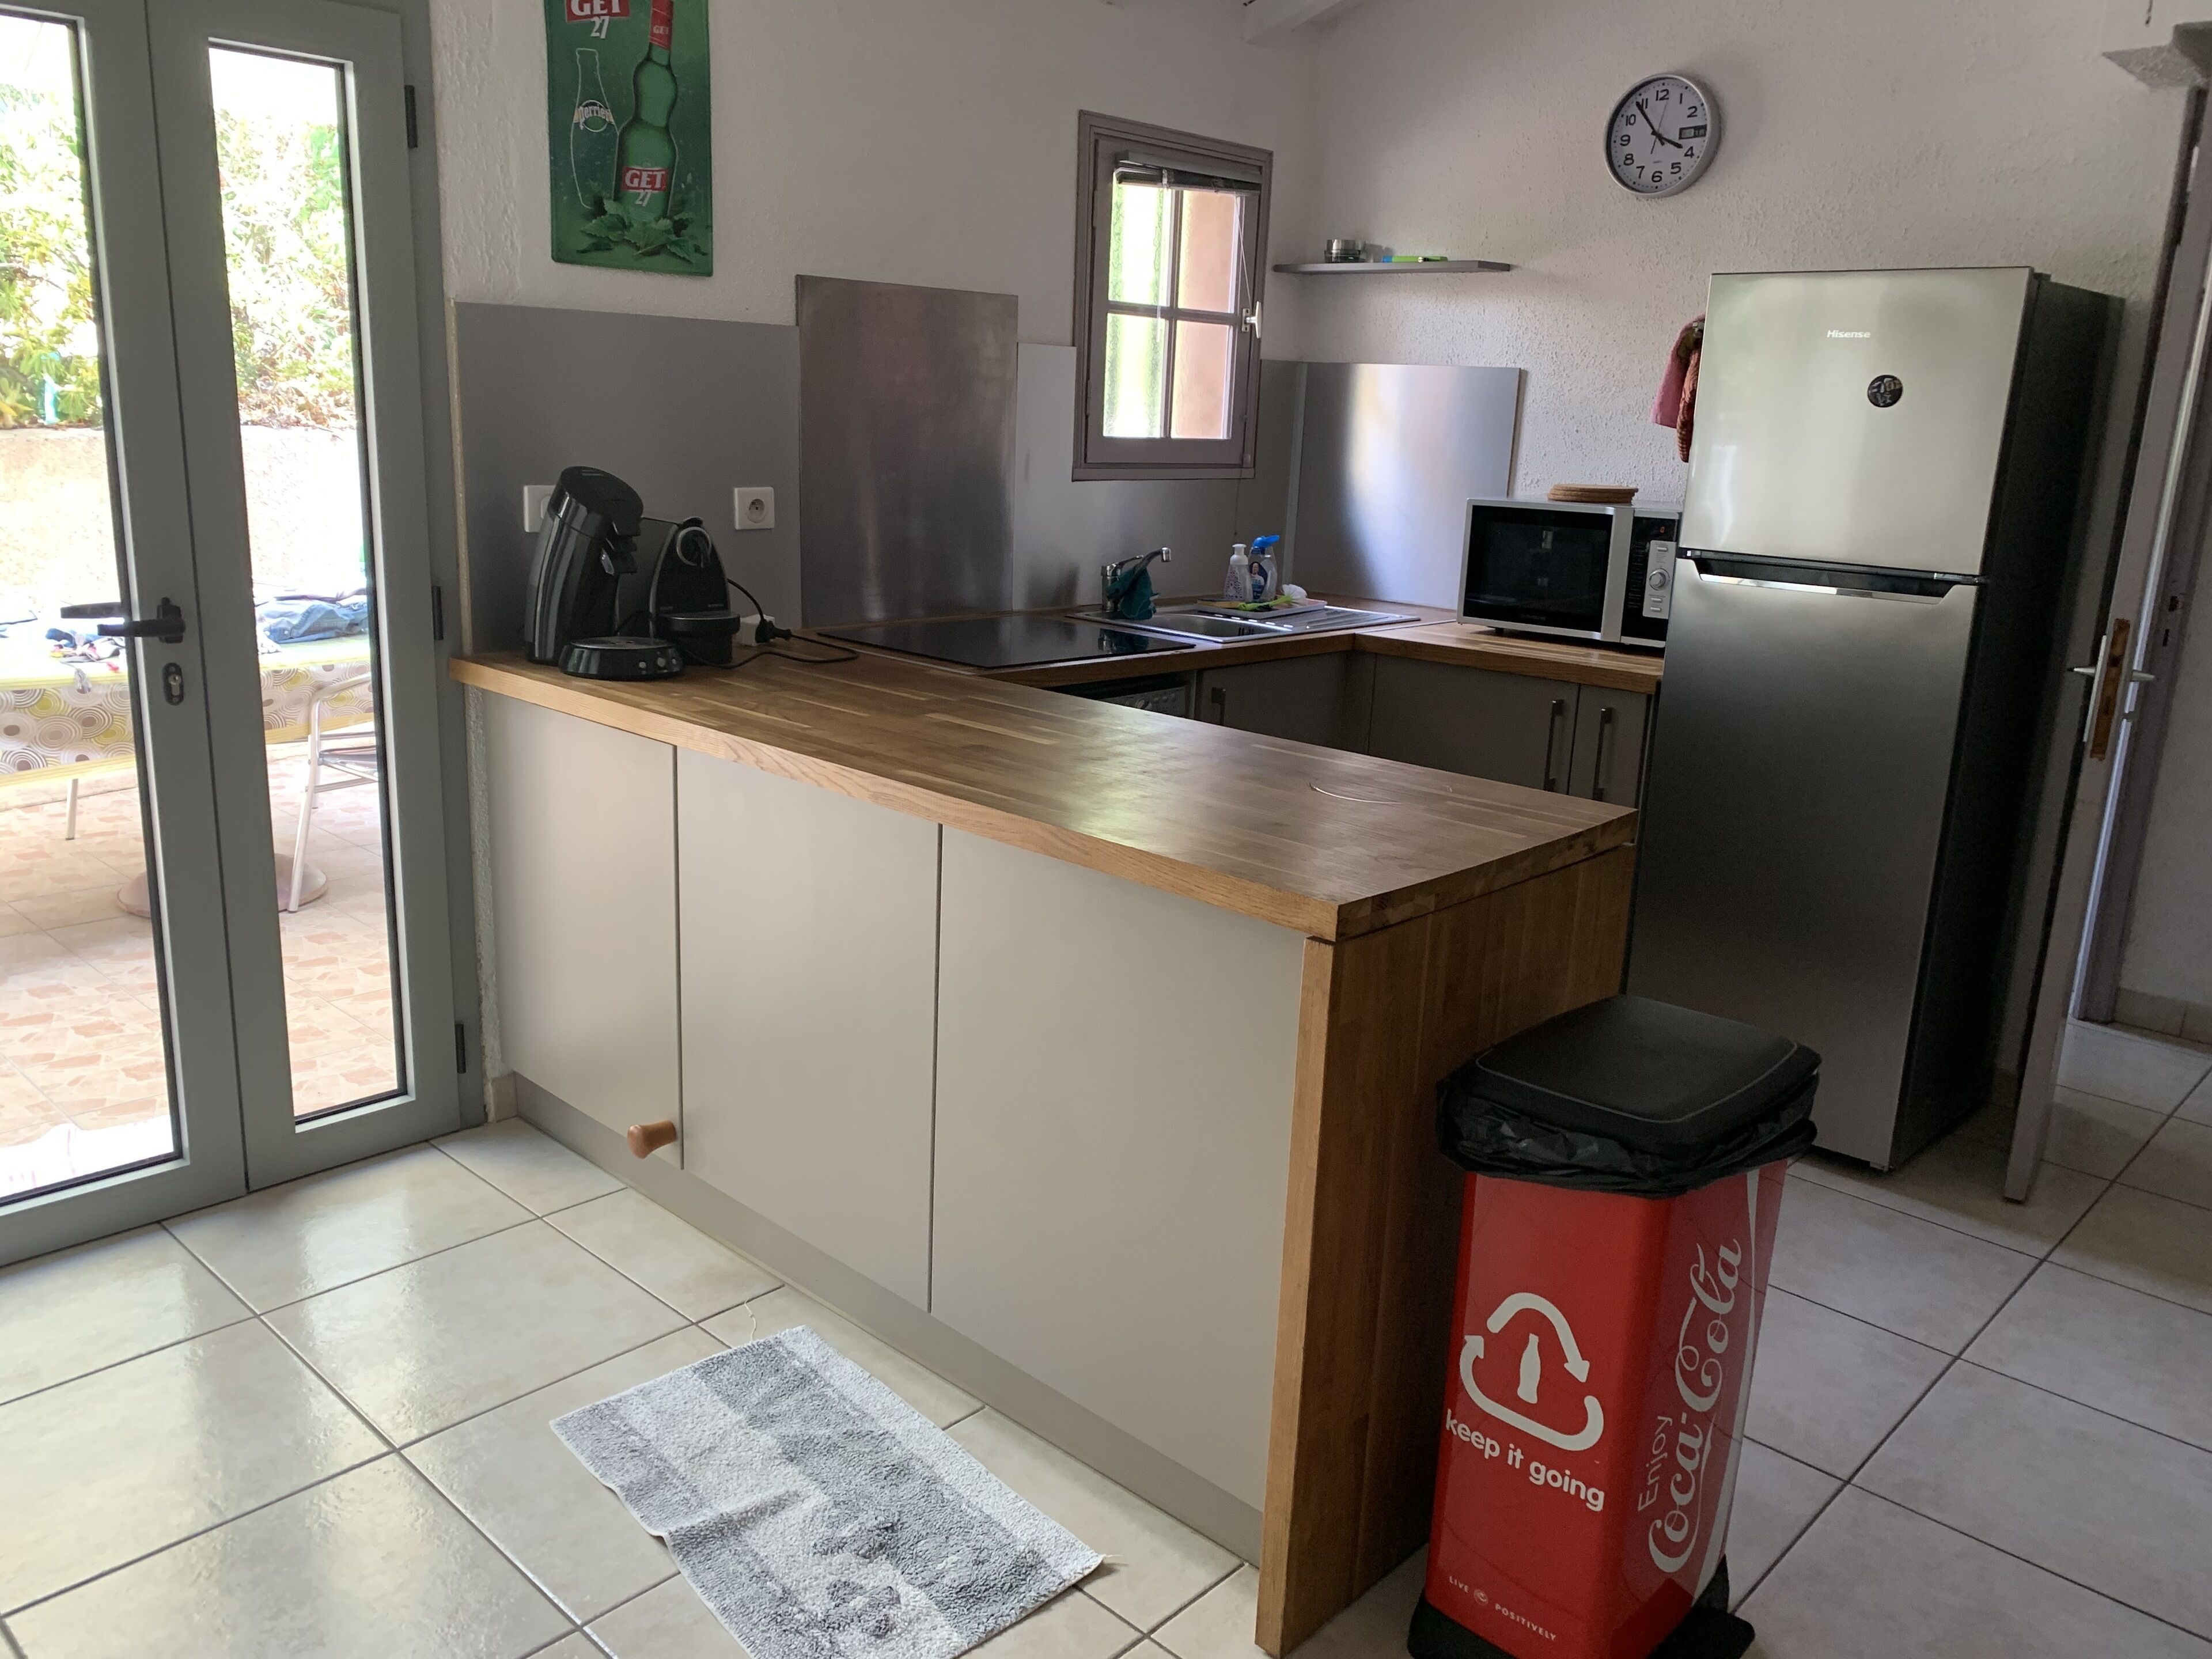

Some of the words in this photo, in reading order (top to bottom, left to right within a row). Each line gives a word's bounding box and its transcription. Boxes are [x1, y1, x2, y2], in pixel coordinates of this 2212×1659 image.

[590, 16, 609, 39] 27
[1655, 89, 1669, 101] 12
[1679, 93, 1683, 104] 1
[1642, 98, 1648, 109] 11
[1687, 106, 1698, 118] 2
[1625, 114, 1636, 126] 10
[1620, 134, 1631, 146] 9
[1684, 146, 1694, 158] 4
[1623, 153, 1634, 166] 8
[1636, 165, 1645, 179] 7
[1671, 162, 1681, 174] 5
[624, 169, 665, 188] GET
[1651, 171, 1663, 183] 6
[635, 189, 652, 206] 27
[1827, 329, 1871, 338] Hisense
[1648, 1238, 1742, 1573] Coca-Cola
[1446, 1408, 1500, 1459] keep
[1508, 1444, 1524, 1469] it
[1529, 1461, 1605, 1512] going
[1638, 1415, 1673, 1512] Enjoy
[1449, 1575, 1469, 1593] LIVE
[1495, 1603, 1556, 1641] POSITIVELY
